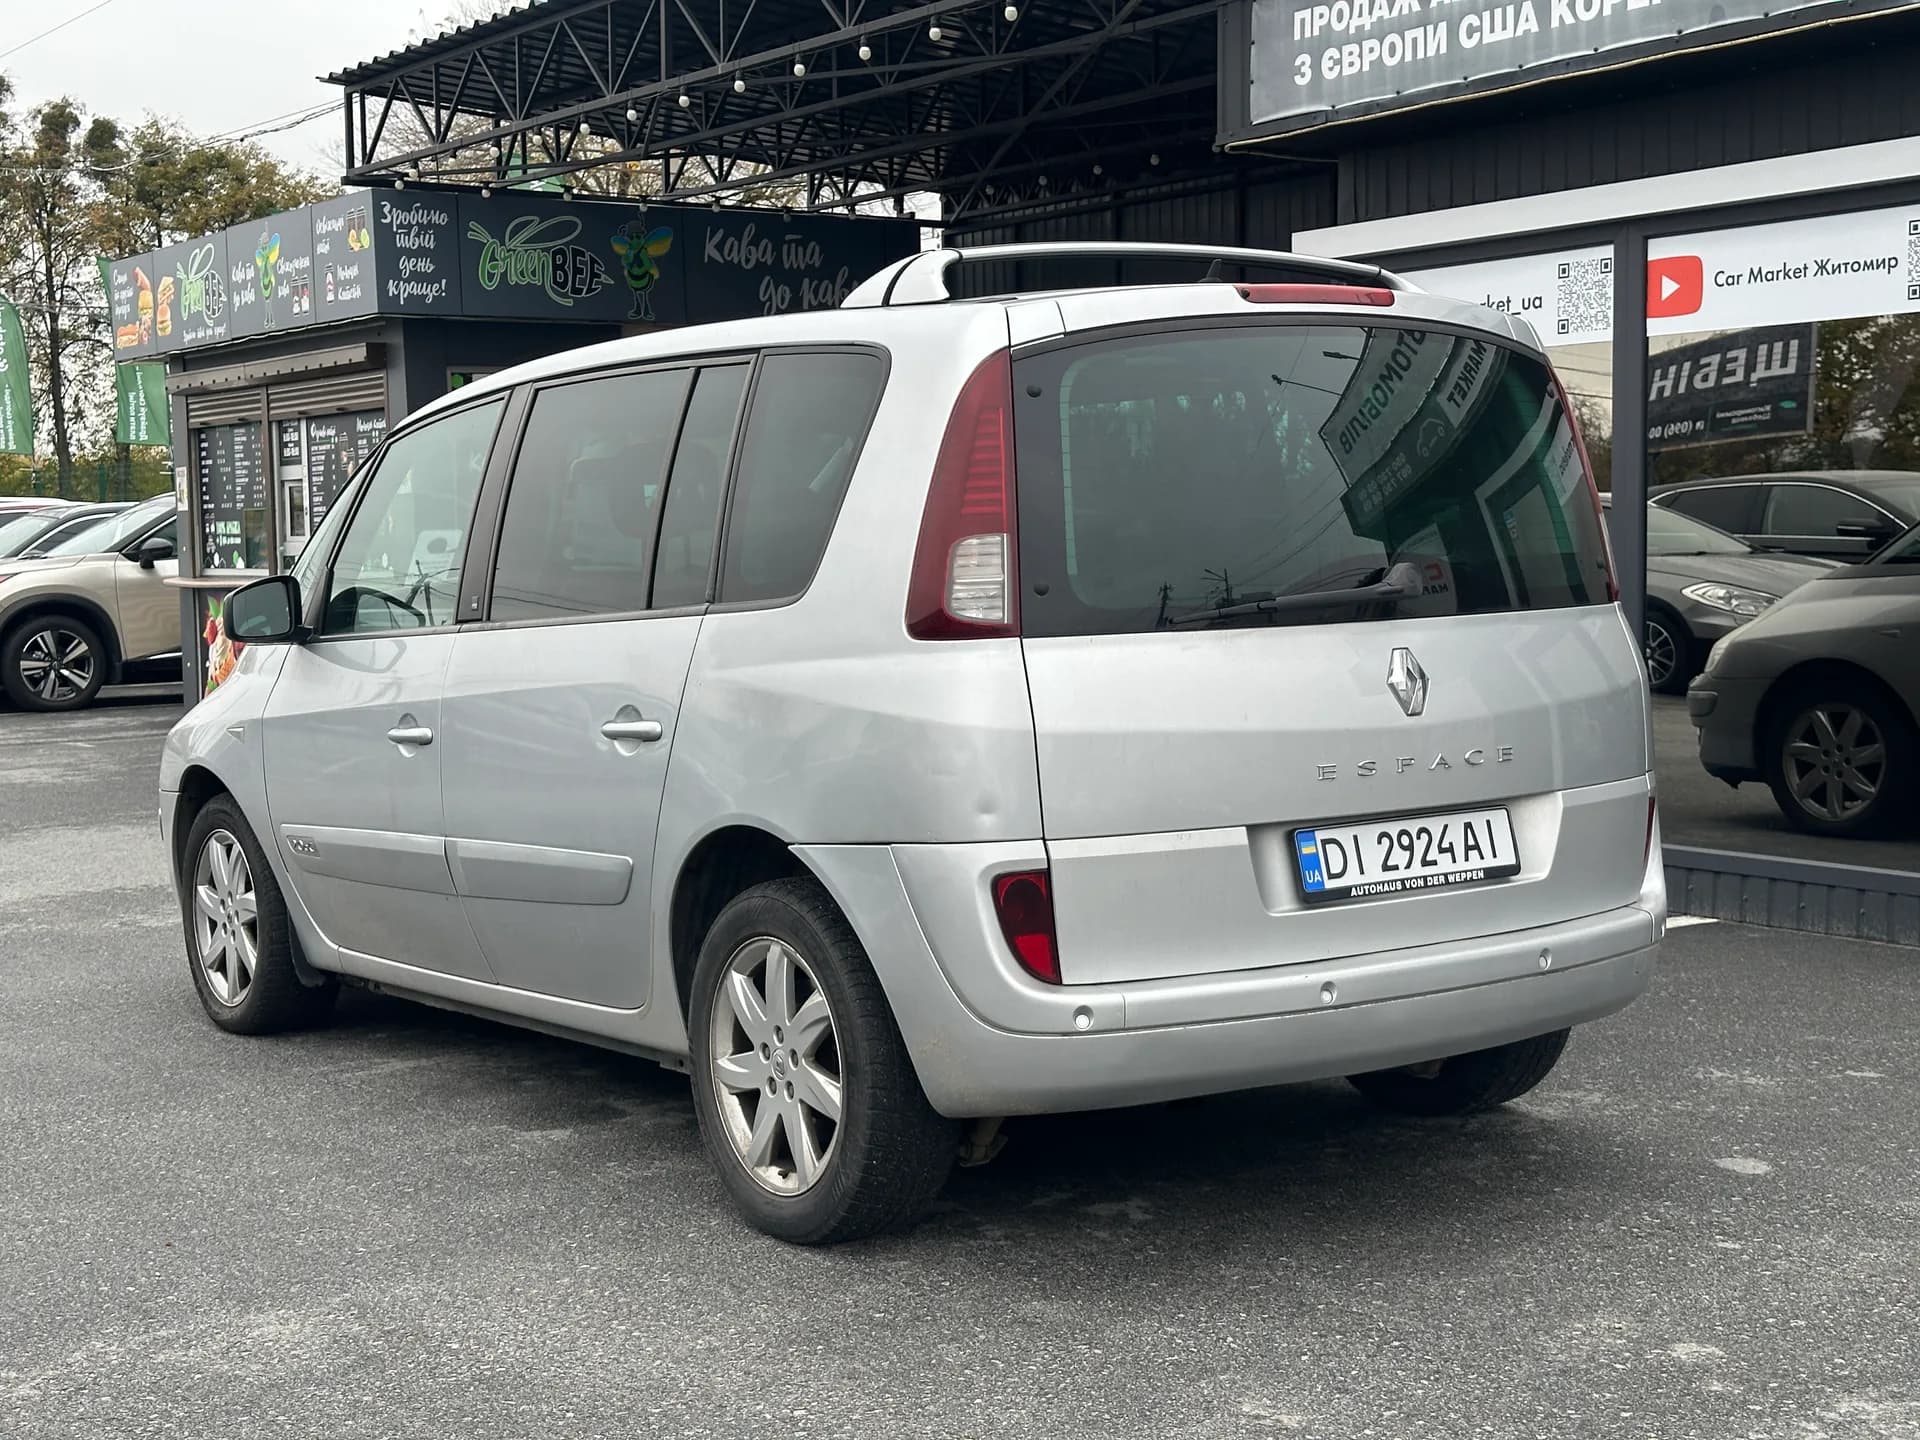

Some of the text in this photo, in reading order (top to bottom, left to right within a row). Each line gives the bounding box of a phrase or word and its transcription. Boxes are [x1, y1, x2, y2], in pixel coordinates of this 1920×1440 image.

[1294, 54, 1312, 86] З
[1321, 21, 1447, 80] ЄВРОПИ
[1458, 10, 1539, 49] США
[380, 201, 449, 232] Зробимо
[396, 225, 436, 250] твій
[704, 223, 824, 270] Кава та
[399, 255, 436, 278] день
[1714, 256, 1899, 287] Car Market Житомир
[387, 279, 446, 305] краще!
[759, 265, 860, 316] до кав
[1316, 746, 1513, 780] ESPACE
[1320, 835, 1365, 880] DI
[1306, 869, 1322, 883] UA
[1350, 870, 1485, 897] AUTOHAUS VON DER WEPPEN
